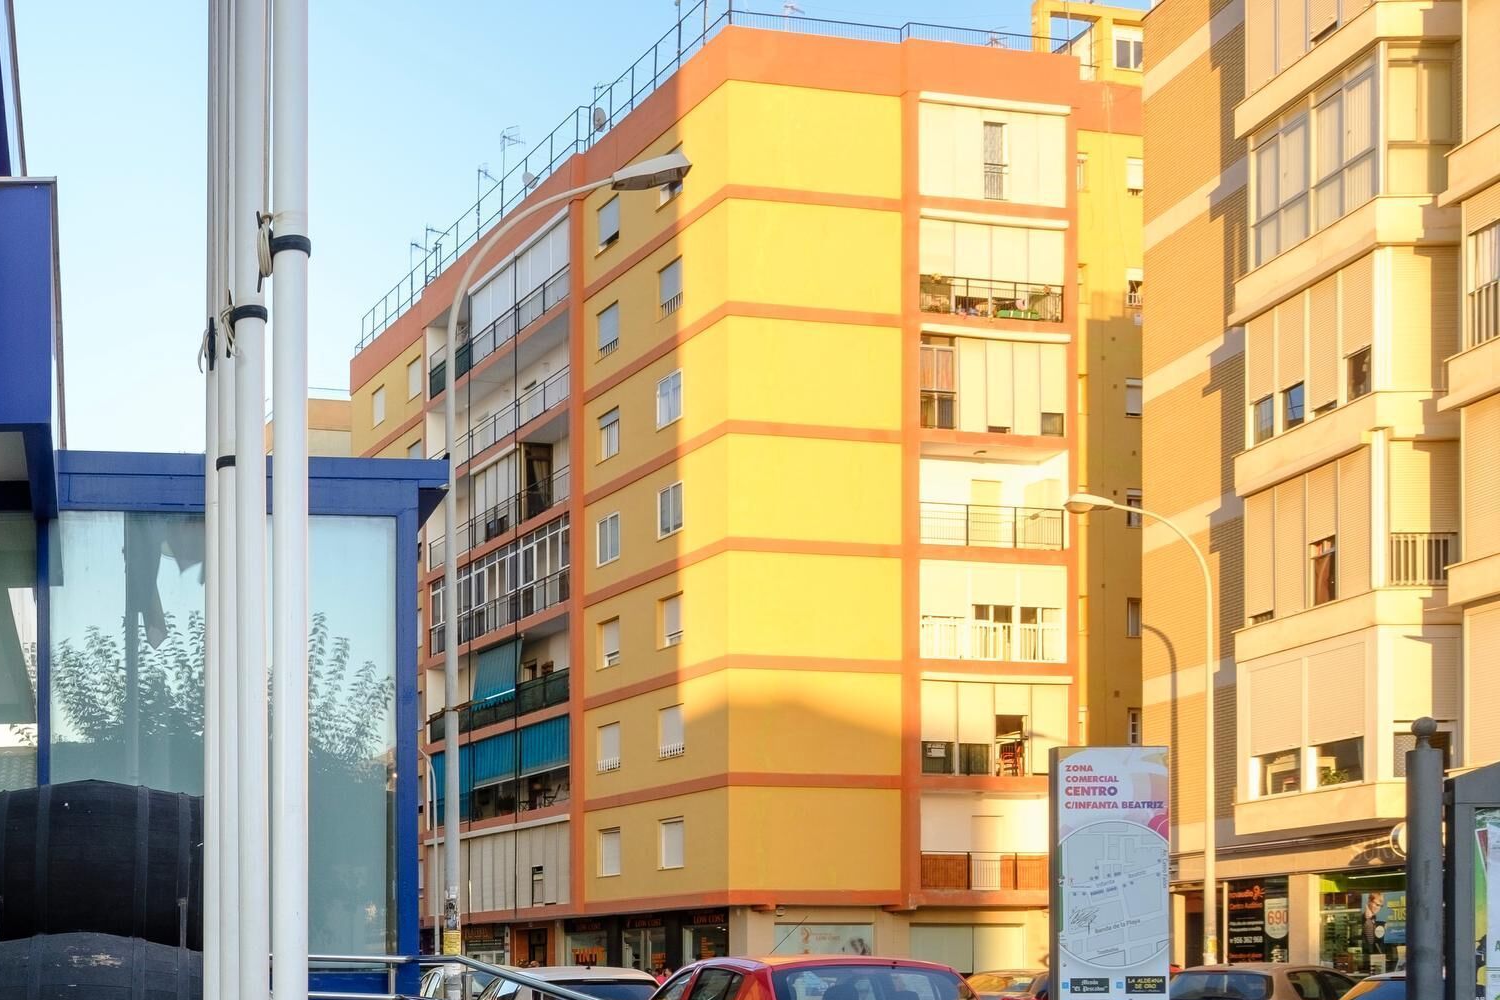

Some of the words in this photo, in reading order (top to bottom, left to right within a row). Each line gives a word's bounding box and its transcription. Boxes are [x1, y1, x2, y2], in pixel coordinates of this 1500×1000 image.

[1065, 775, 1120, 783] COMERCIAL
[1065, 786, 1118, 796] CENTRO
[1065, 801, 1119, 809] C/INFANTA
[1121, 800, 1164, 809] BEATRIZ
